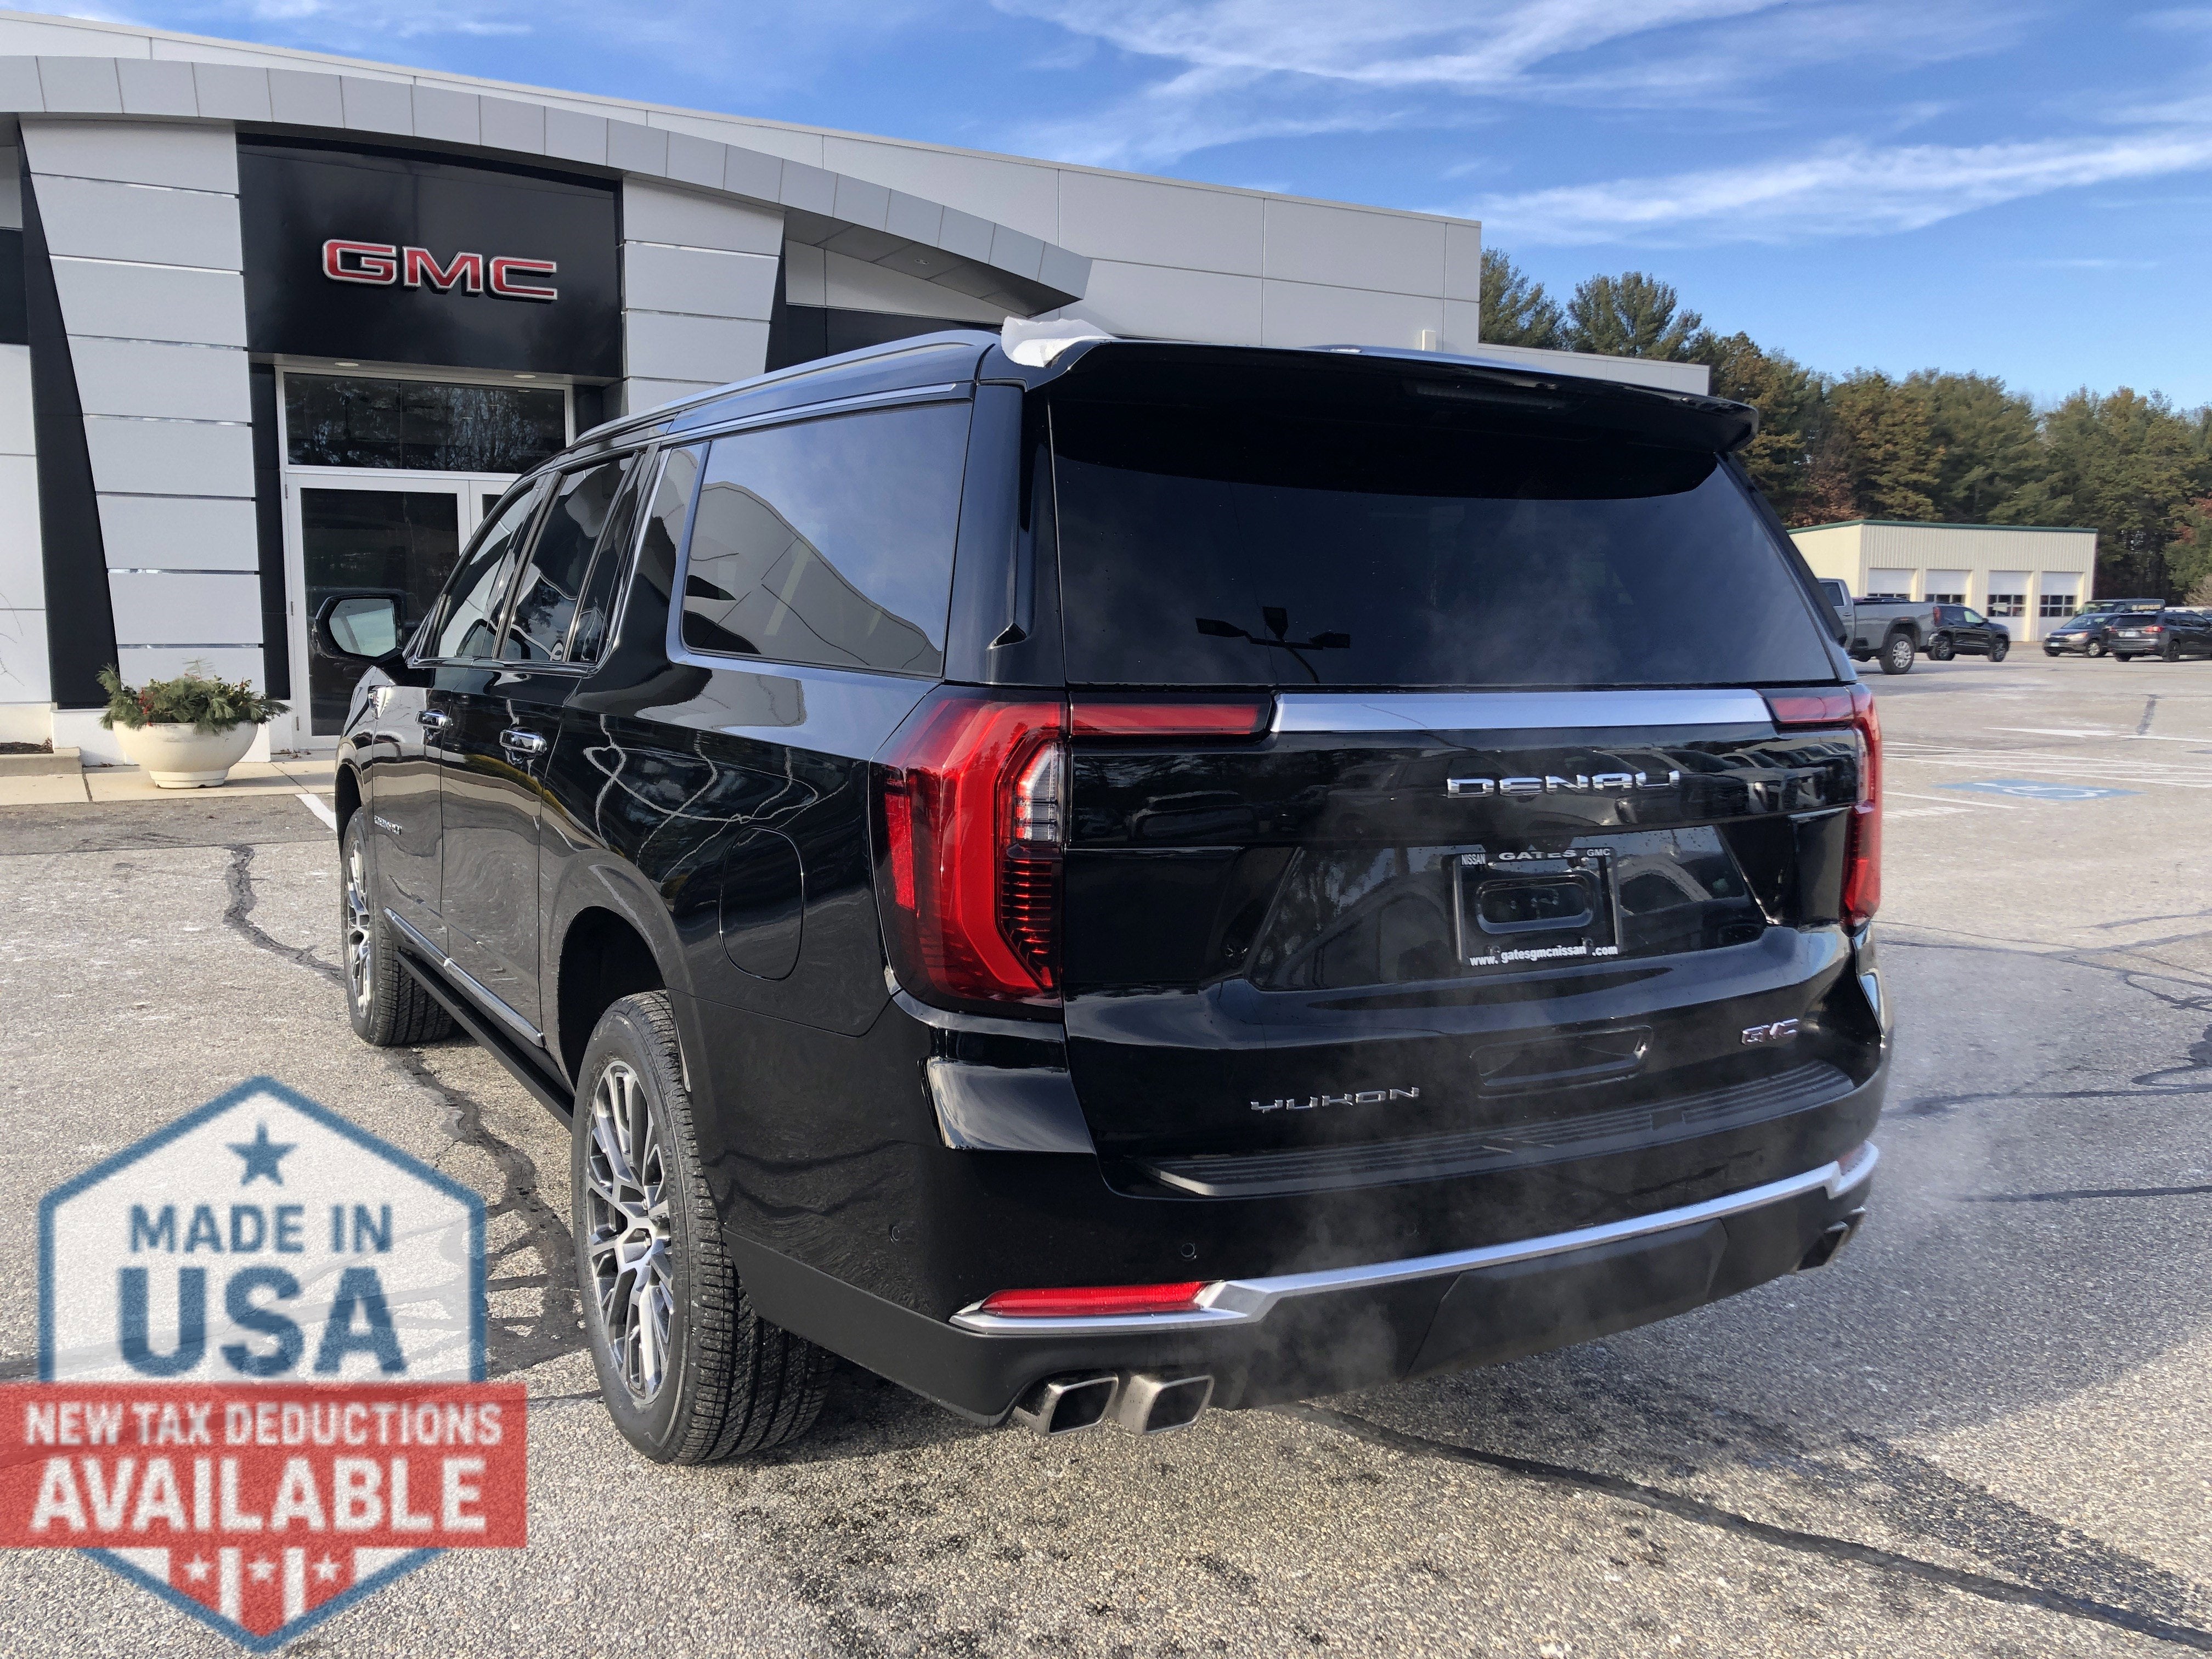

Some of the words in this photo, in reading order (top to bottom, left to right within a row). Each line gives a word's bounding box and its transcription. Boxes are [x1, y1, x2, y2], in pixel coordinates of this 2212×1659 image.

[321, 239, 558, 301] GMC
[1447, 770, 1680, 799] DENALI
[1460, 853, 1486, 865] NISSAN
[1498, 849, 1578, 860] GATES
[1586, 848, 1611, 857] GMC
[1250, 1086, 1420, 1114] YUKON
